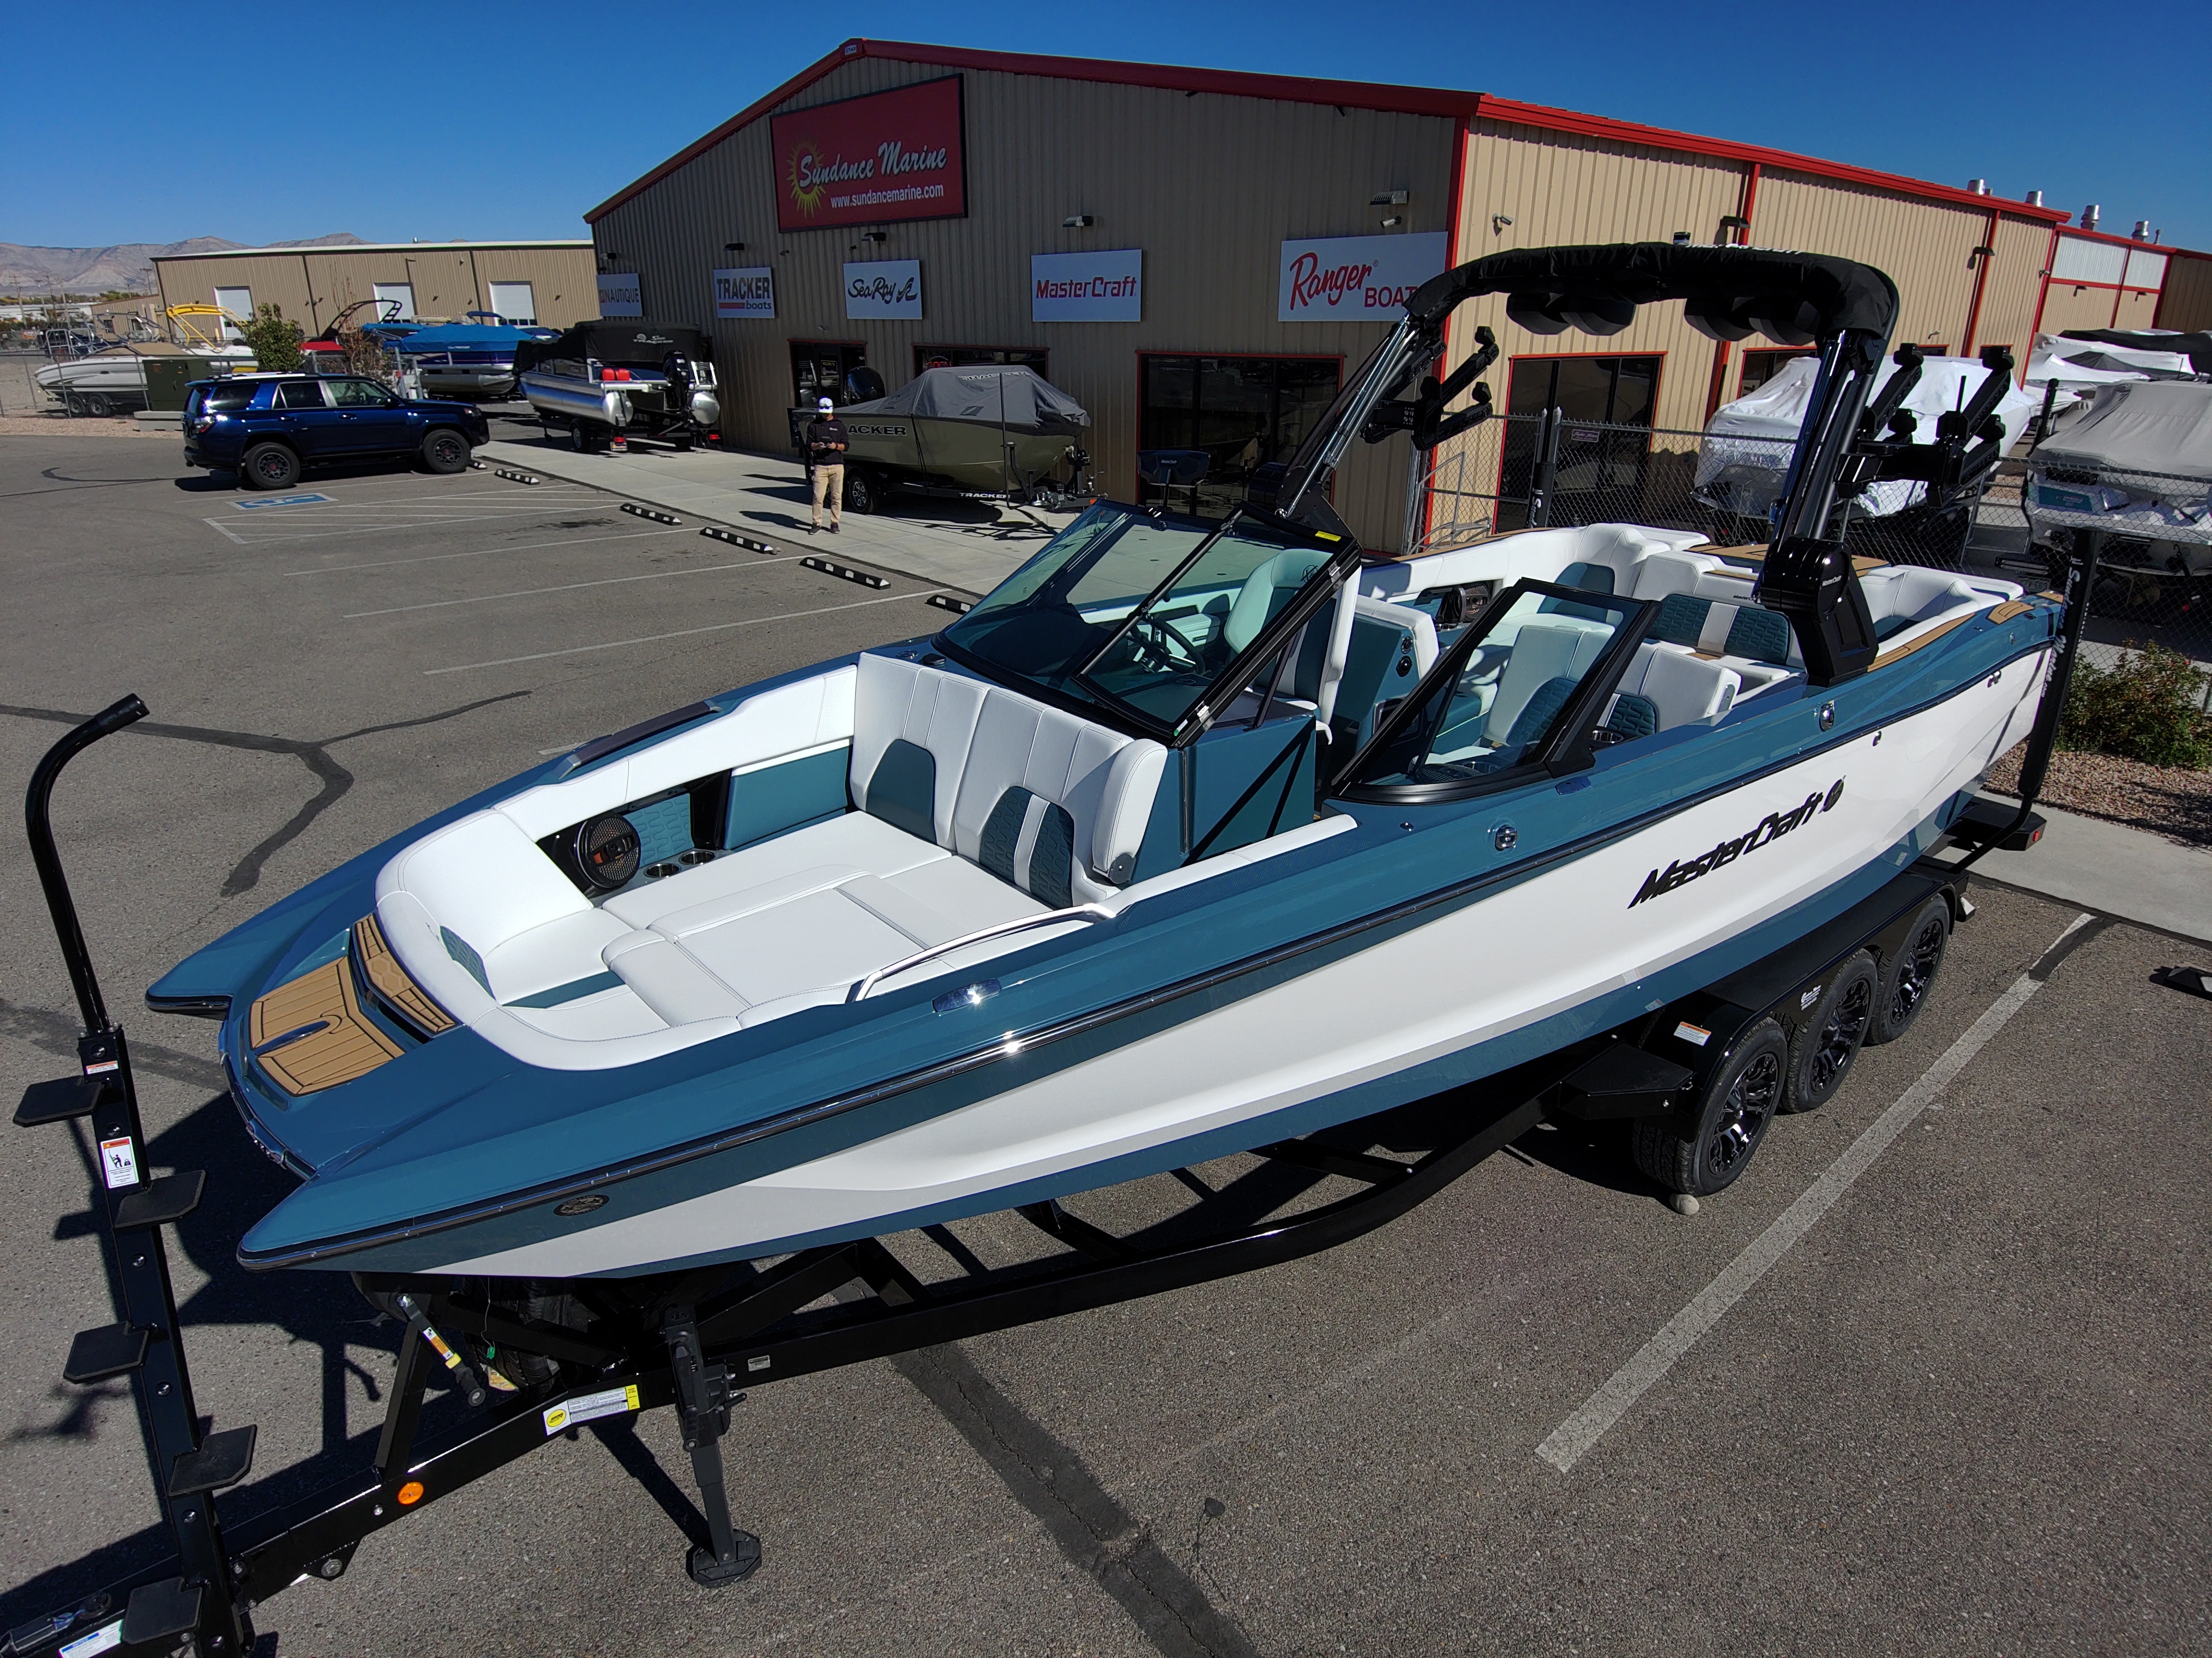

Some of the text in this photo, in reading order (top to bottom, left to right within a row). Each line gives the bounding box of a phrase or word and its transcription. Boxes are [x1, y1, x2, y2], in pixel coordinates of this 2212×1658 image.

[800, 141, 947, 188] Sundance Marine
[831, 184, 943, 208] www.sundancemarine.com
[717, 277, 770, 299] TRACKER
[1036, 276, 1137, 298] MasterCraft
[1290, 252, 1372, 310] Ranger
[605, 288, 640, 303] NAUTIQUE
[746, 300, 772, 309] boats
[847, 424, 907, 436] ACKER
[1627, 792, 1823, 909] MasterCraft
